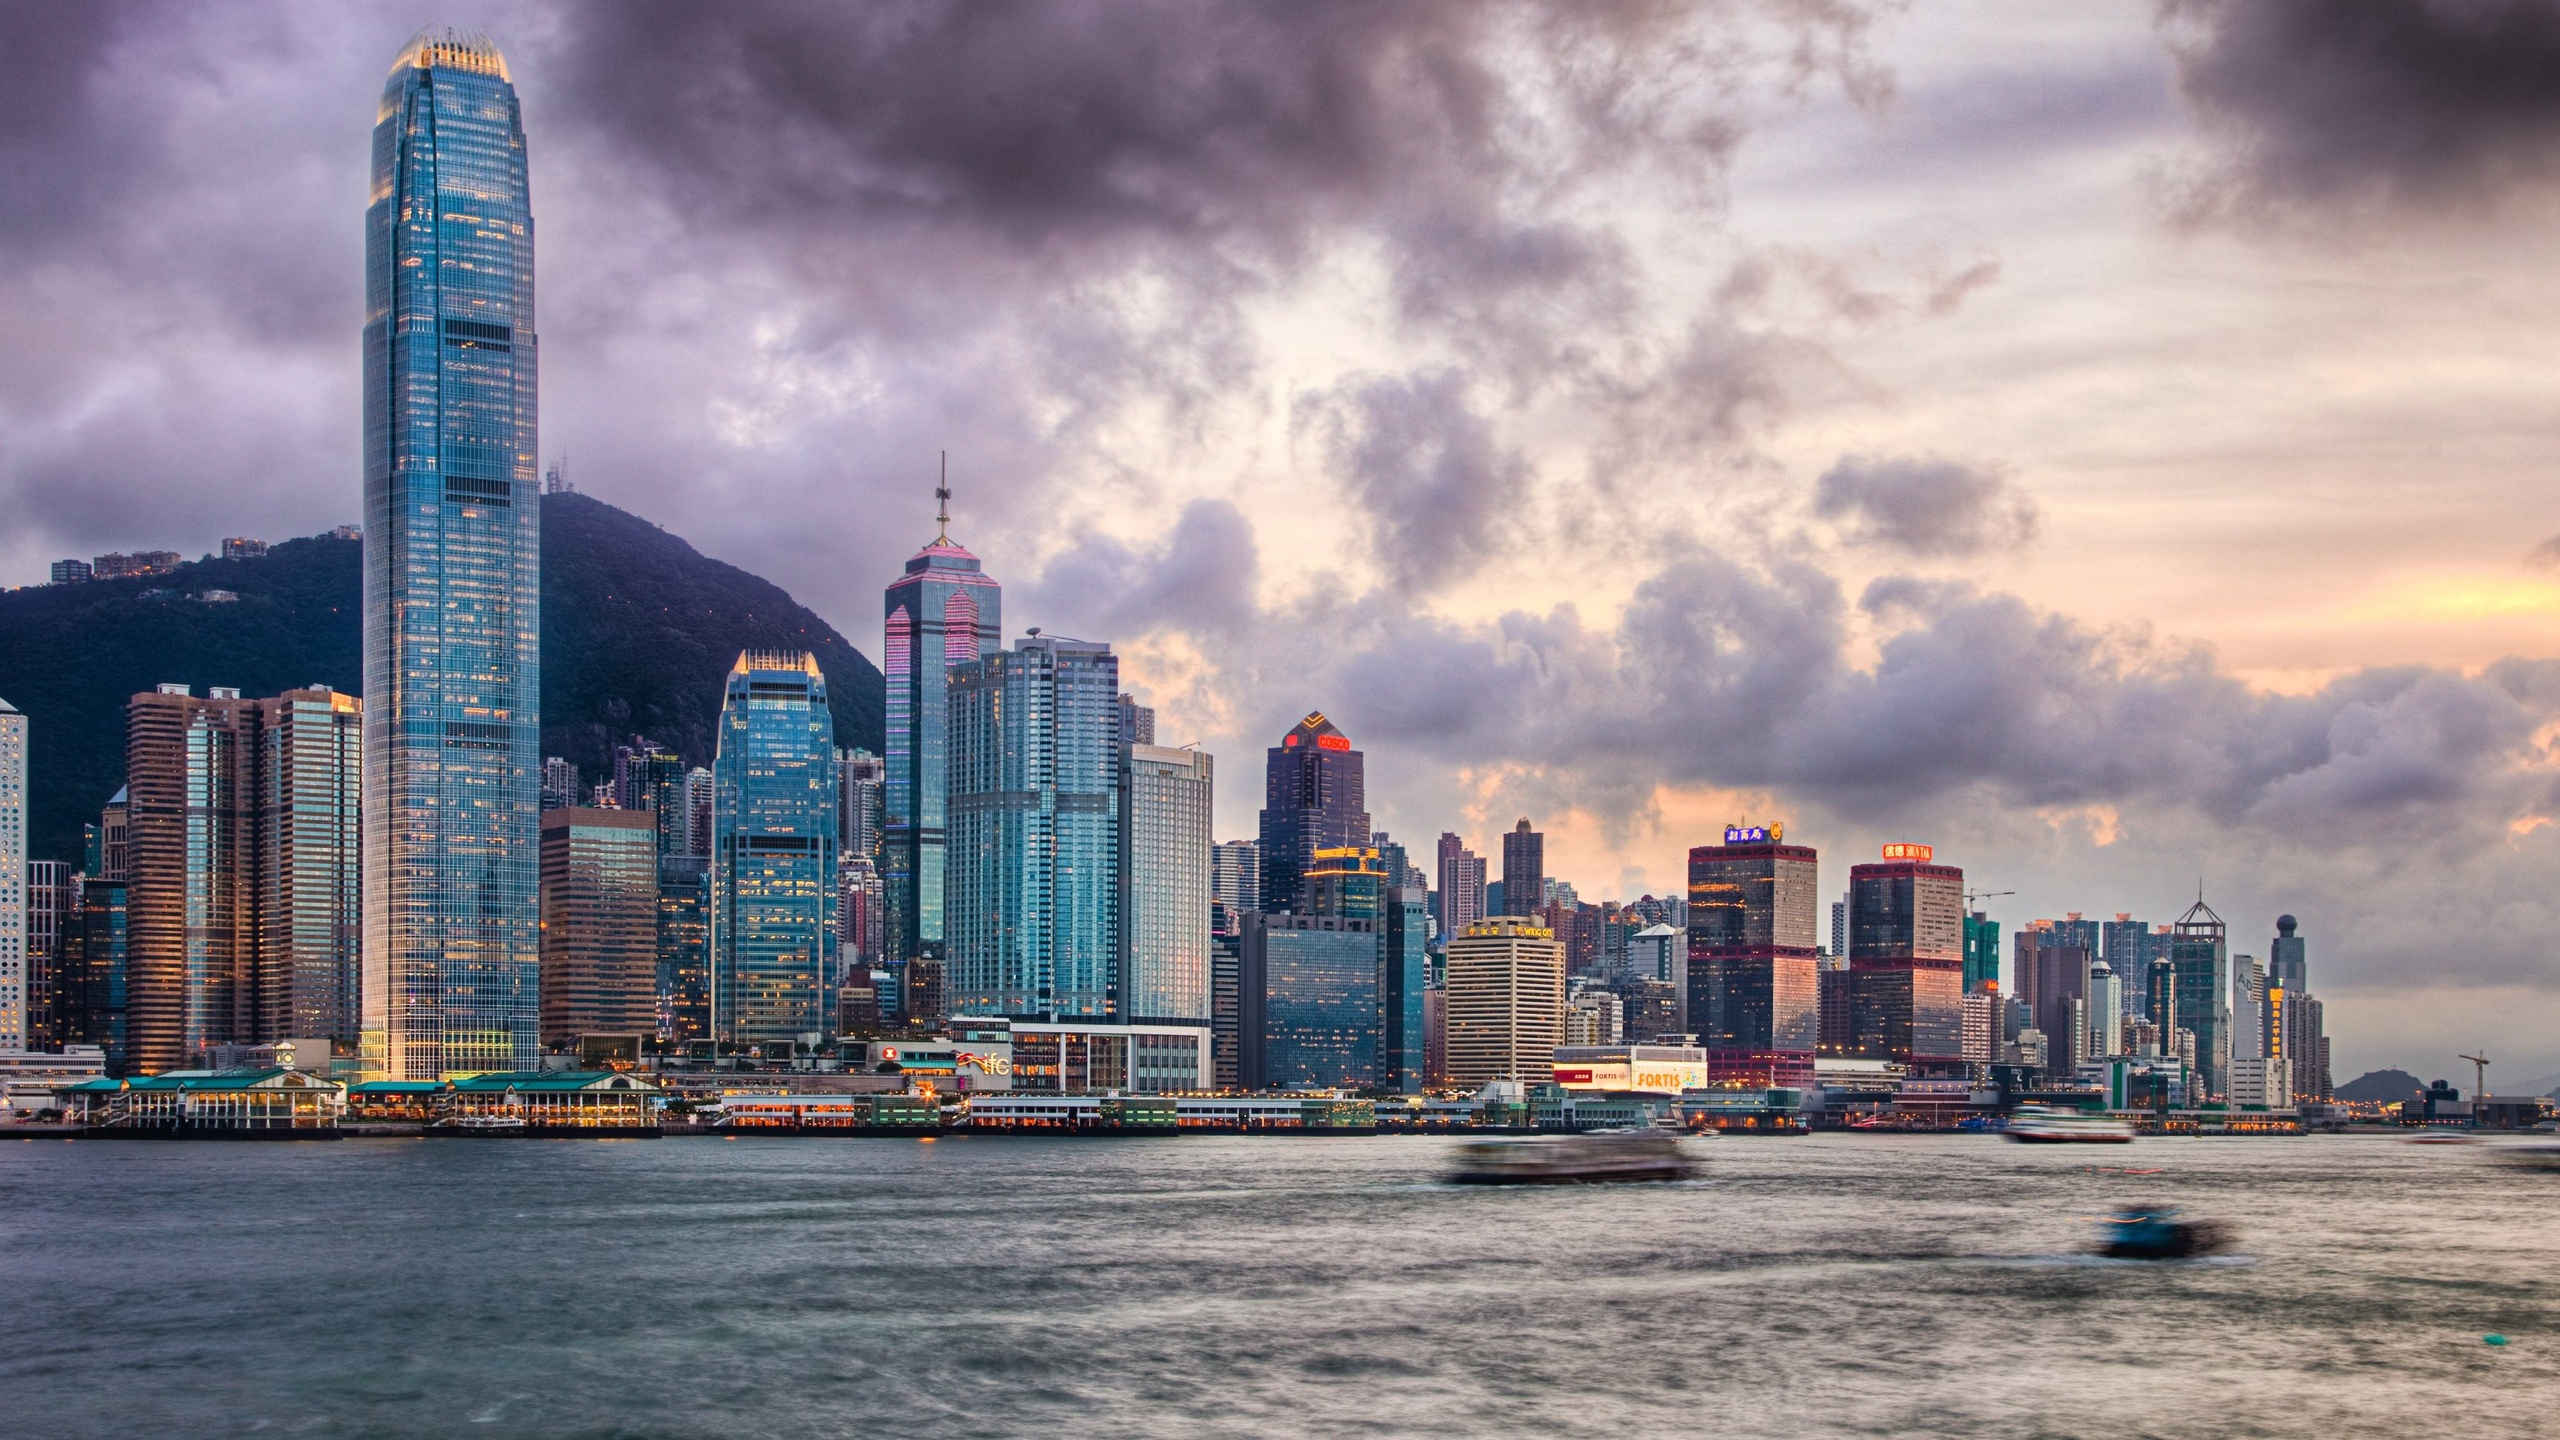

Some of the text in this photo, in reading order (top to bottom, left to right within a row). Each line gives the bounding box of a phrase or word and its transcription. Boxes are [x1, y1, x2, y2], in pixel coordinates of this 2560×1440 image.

[1319, 735, 1350, 751] COSCO
[984, 1053, 1010, 1075] ifc
[1638, 1073, 1680, 1087] FORTIS
